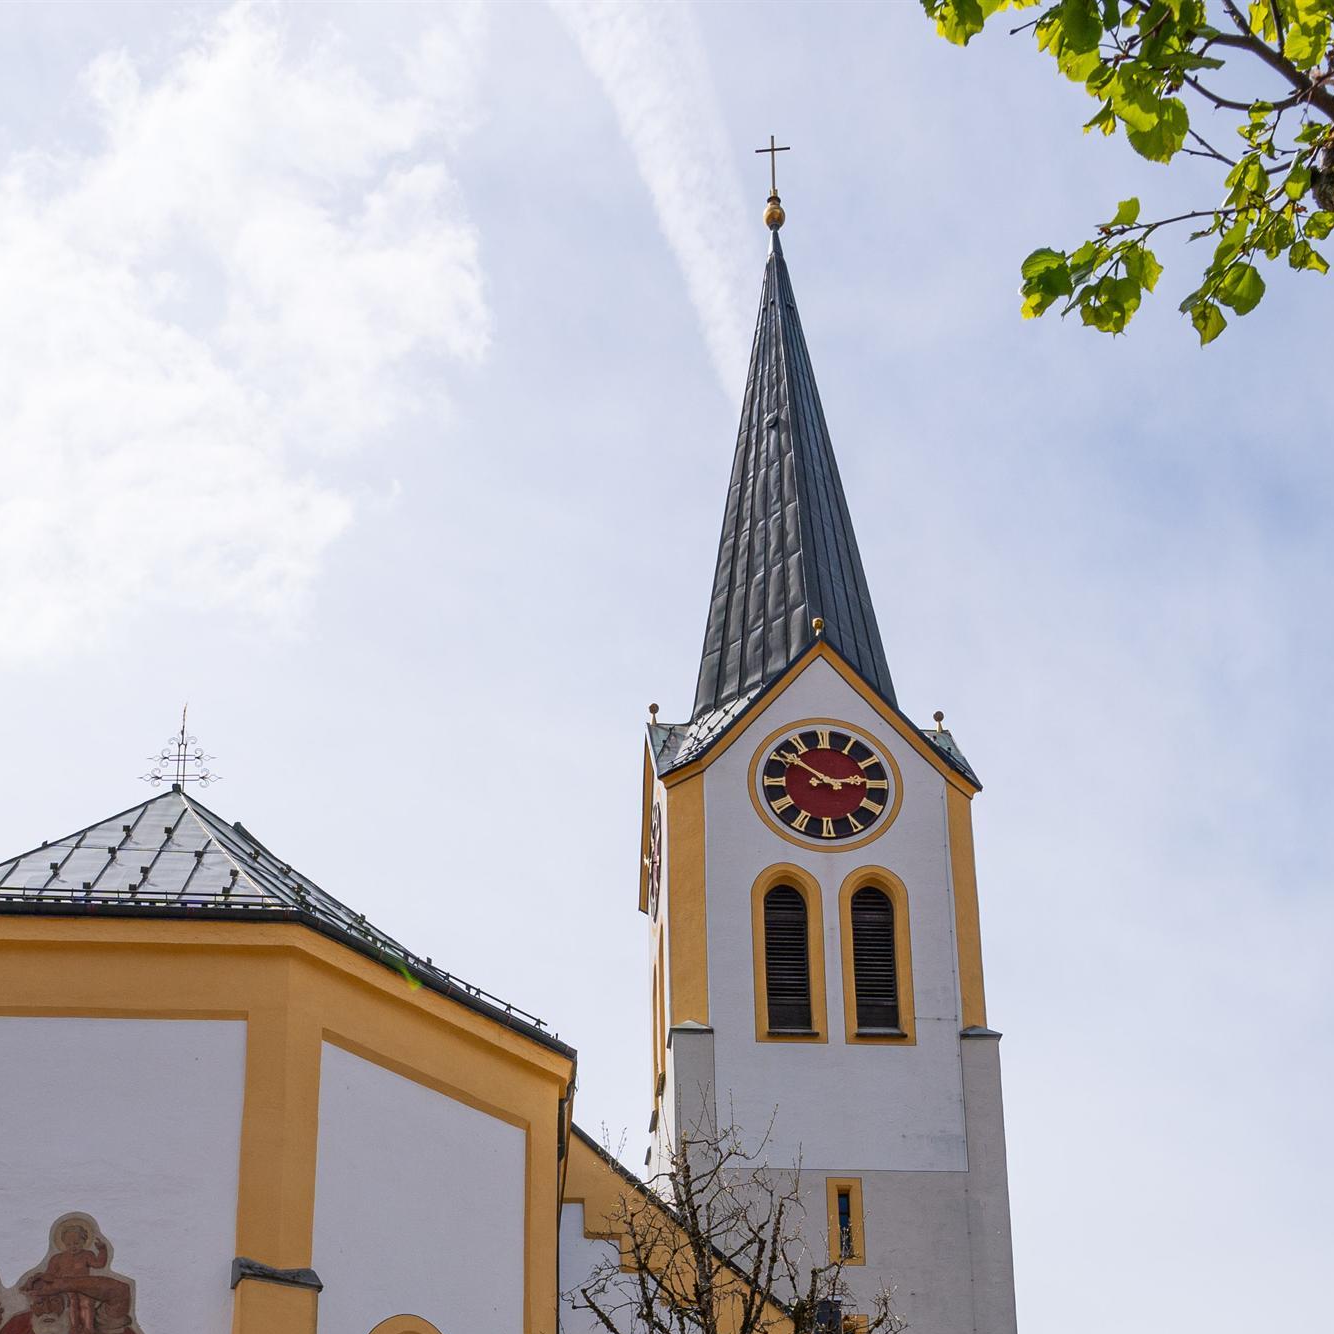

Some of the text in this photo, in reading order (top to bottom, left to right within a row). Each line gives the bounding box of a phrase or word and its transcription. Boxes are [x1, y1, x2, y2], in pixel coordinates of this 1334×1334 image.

[788, 734, 809, 754] XI
[816, 730, 831, 749] XII
[857, 754, 879, 770] II
[763, 775, 786, 787] IX
[866, 779, 888, 790] III
[769, 795, 795, 815] VIII
[790, 809, 811, 832] VII
[821, 817, 836, 838] VI
[846, 812, 865, 833] V
